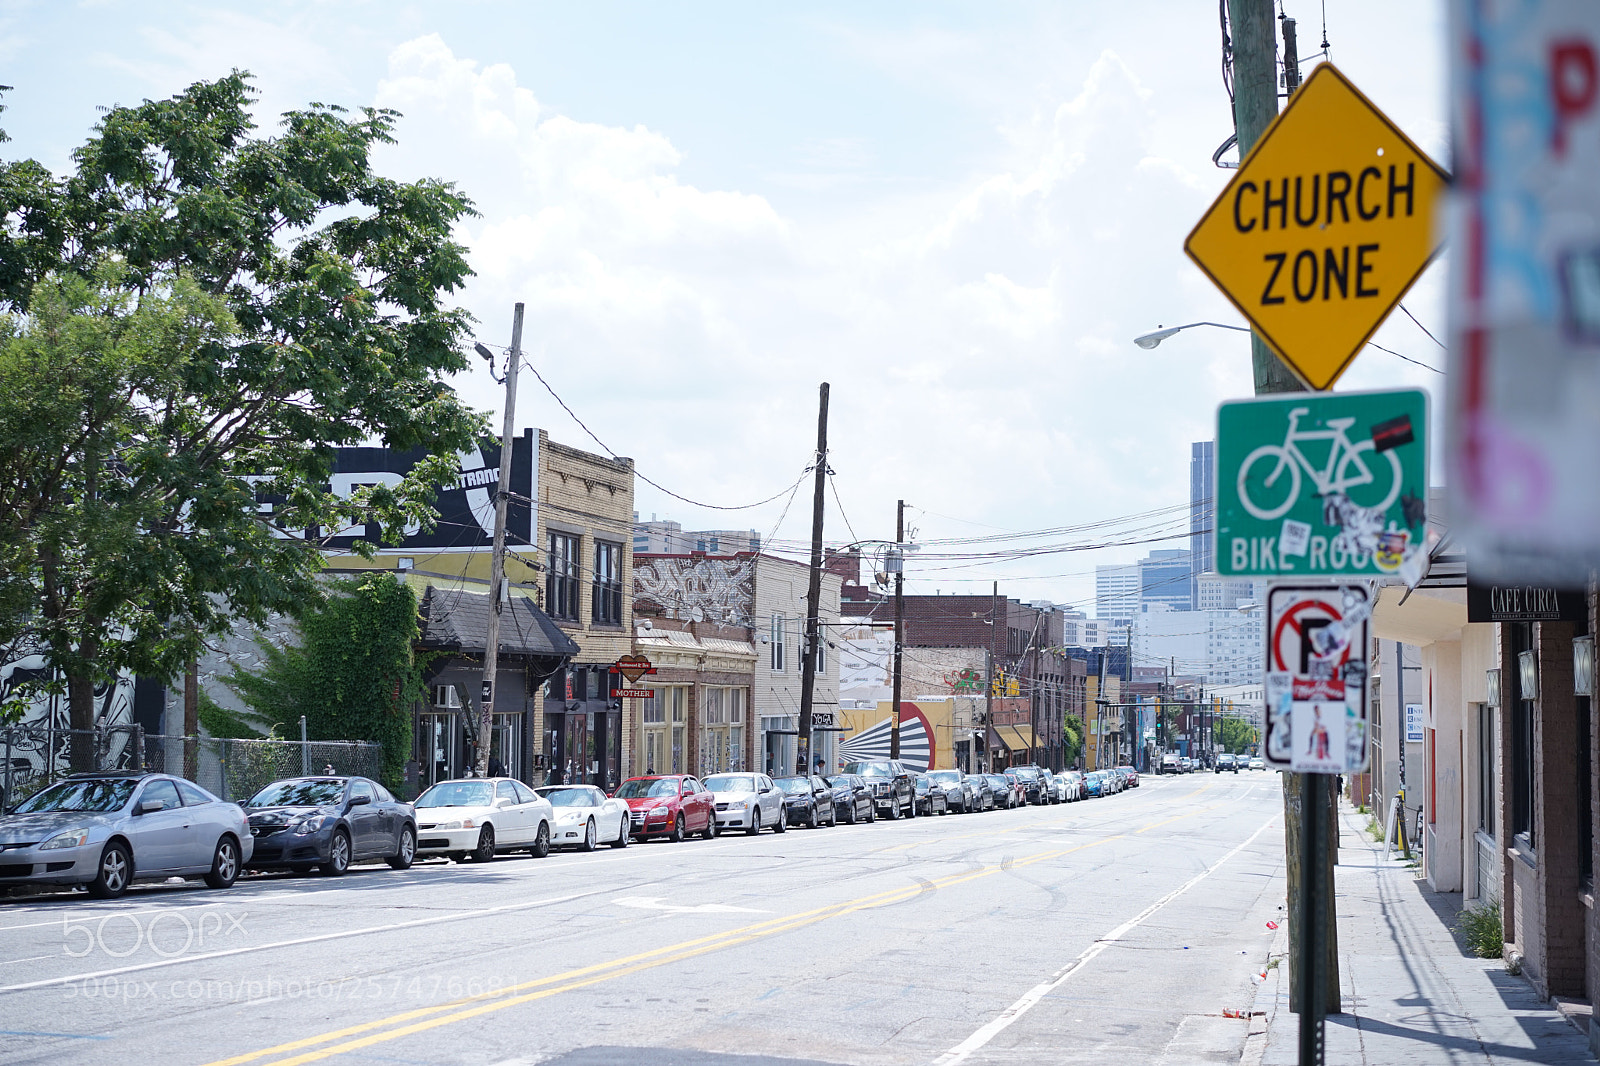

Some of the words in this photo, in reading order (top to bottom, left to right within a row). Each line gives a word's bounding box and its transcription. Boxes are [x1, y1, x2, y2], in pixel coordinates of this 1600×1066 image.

[1233, 163, 1415, 234] CHURCH
[1261, 243, 1380, 307] ZONE
[1491, 585, 1520, 612] CAFÉ
[1525, 585, 1560, 611] CIRCA
[813, 713, 832, 725] YOGA
